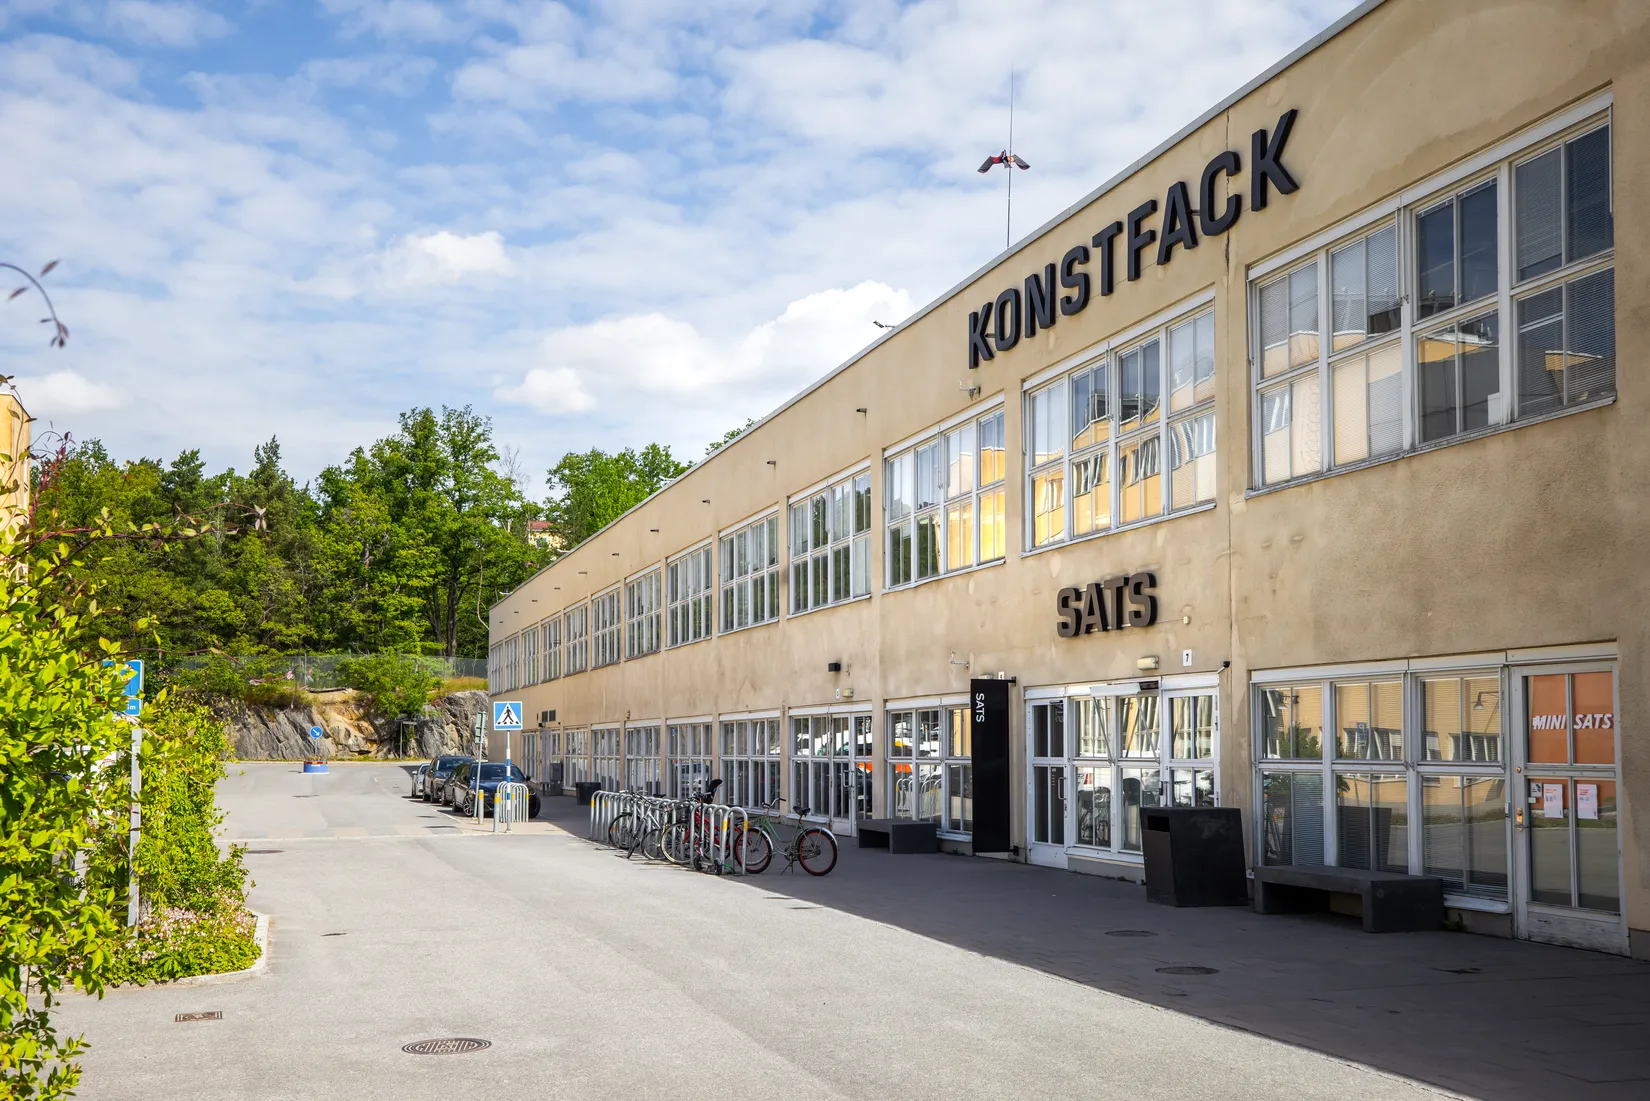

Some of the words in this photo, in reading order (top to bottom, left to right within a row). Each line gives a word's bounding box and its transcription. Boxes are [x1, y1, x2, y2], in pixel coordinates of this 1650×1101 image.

[968, 109, 1299, 369] KONSTFACK
[1057, 573, 1157, 637] SATS
[975, 693, 985, 722] SATS
[1533, 715, 1566, 730] MINI
[1573, 713, 1613, 729] SATS
